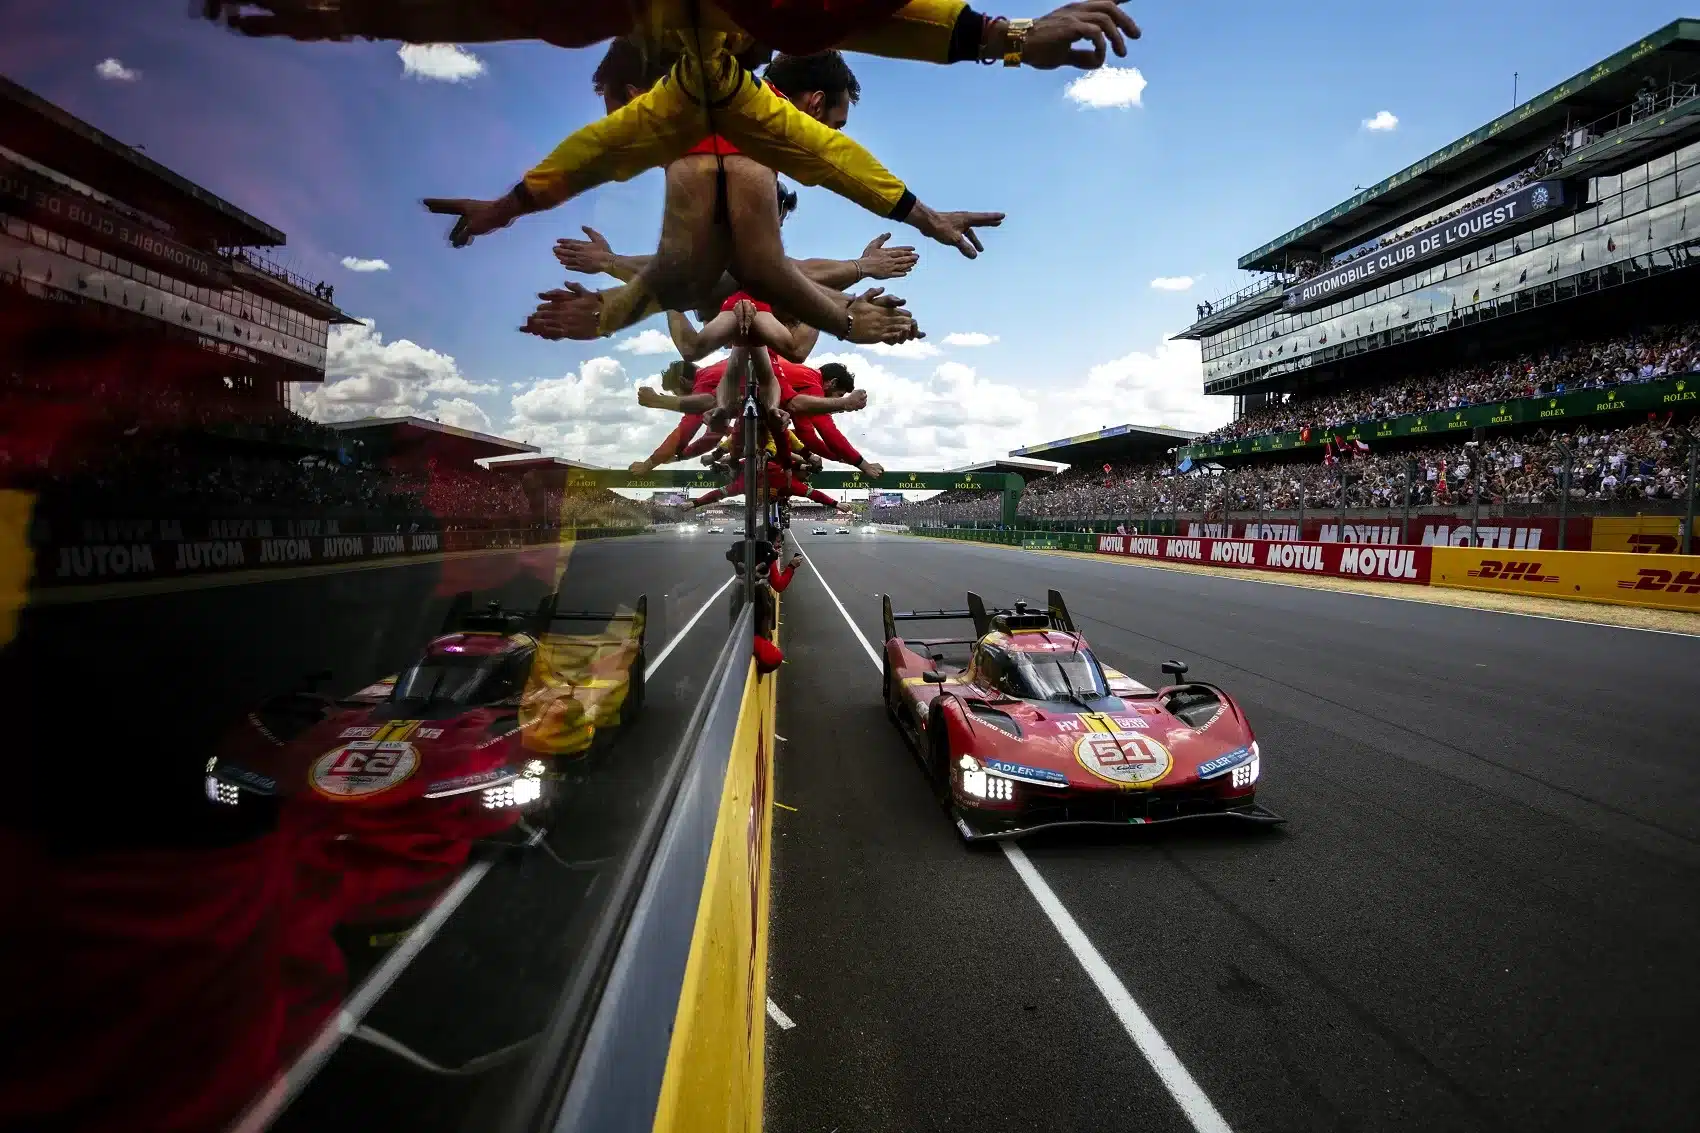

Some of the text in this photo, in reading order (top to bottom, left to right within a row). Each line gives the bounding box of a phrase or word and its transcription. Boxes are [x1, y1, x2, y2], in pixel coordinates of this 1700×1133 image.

[1303, 202, 1517, 301] AUTOMOBILE CLUB DE L'OUEST
[1597, 401, 1625, 411] ROLEX
[1663, 391, 1697, 403] ROLEX
[1491, 415, 1513, 423] ROLEX
[1540, 408, 1564, 418] ROLEX
[1410, 425, 1428, 433] ROLEX
[1448, 420, 1468, 428] ROLEX
[1100, 536, 1124, 552] MOTUL
[1129, 537, 1158, 555] MOTUL
[1166, 539, 1202, 559] MOTUL
[1210, 541, 1255, 564] MOTUL
[1266, 544, 1324, 570] MOTUL
[1339, 547, 1417, 578] MOTUL
[1476, 560, 1546, 582] DHL
[1634, 568, 1700, 593] DH
[966, 712, 1024, 742] RICHARD MILLE
[1055, 720, 1080, 732] HY
[1093, 742, 1152, 763] 51
[992, 762, 1034, 776] ADLER
[1200, 756, 1232, 774] ADLER
